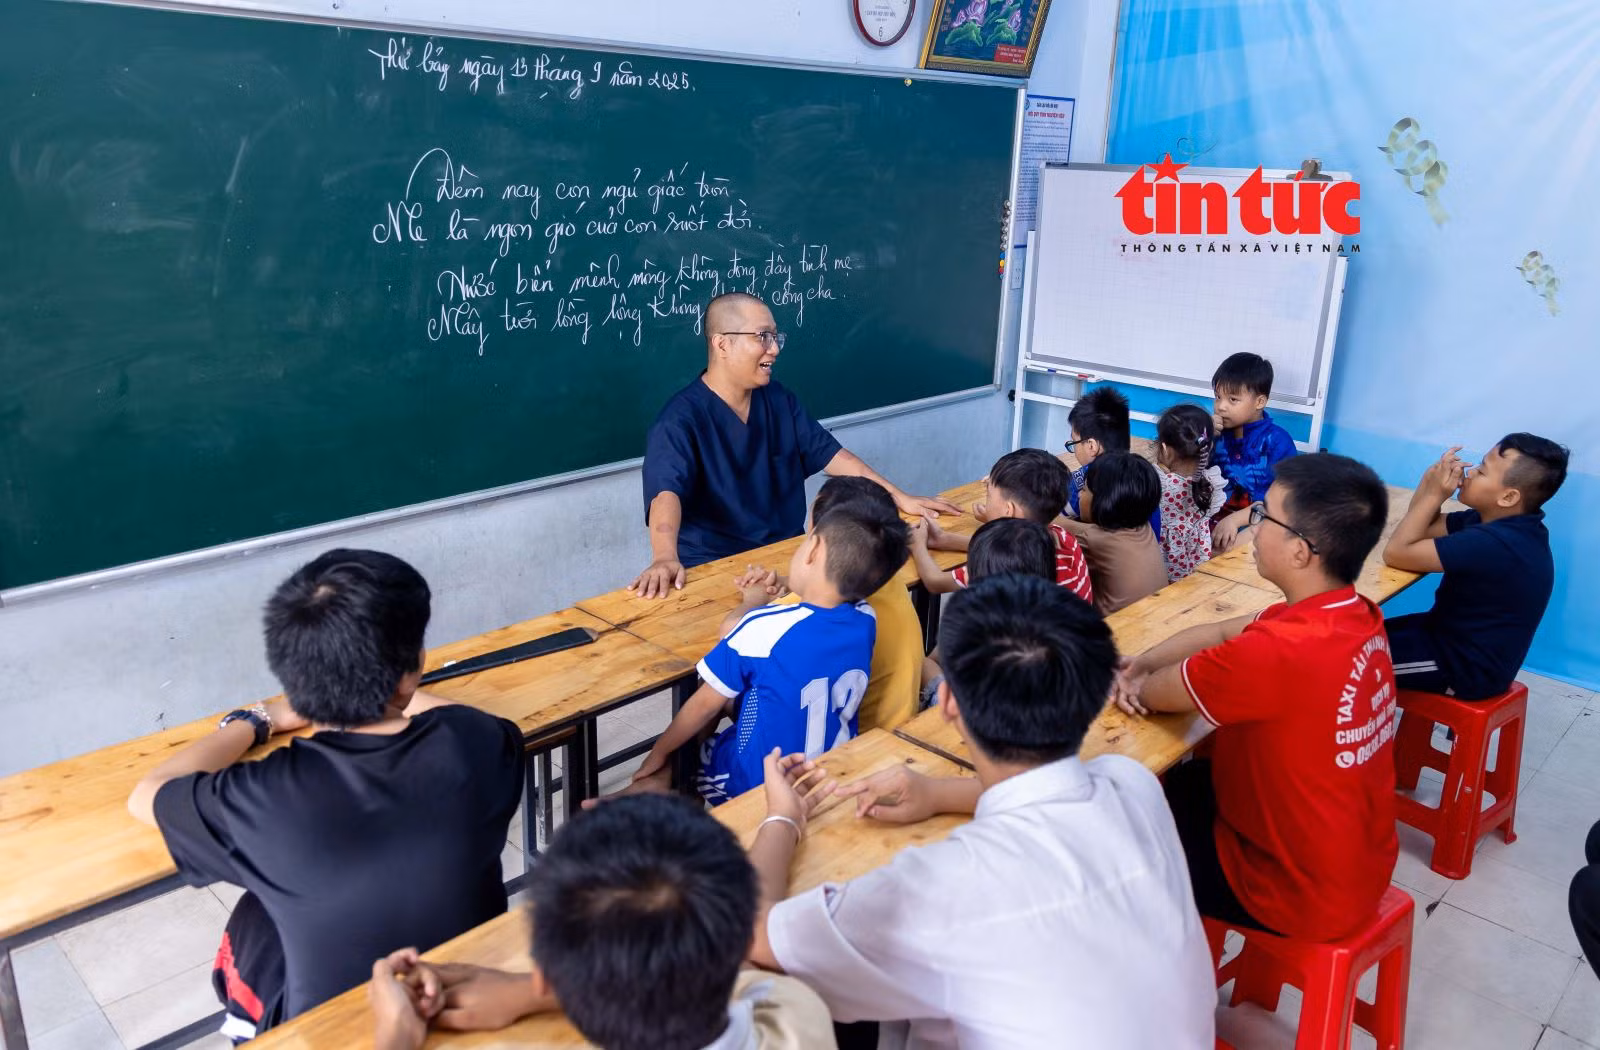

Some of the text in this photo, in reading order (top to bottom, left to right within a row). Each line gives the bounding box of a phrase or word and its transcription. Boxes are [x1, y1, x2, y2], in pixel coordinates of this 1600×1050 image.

[534, 53, 584, 100] tháng
[590, 61, 602, 83] 9
[609, 60, 643, 87] năm
[502, 184, 541, 220] nay
[555, 182, 591, 200] con
[601, 167, 642, 215] ngủ
[647, 161, 689, 214] giấc
[446, 208, 481, 241] là
[586, 205, 617, 235] của
[624, 216, 657, 234] con
[516, 259, 554, 295] biển
[569, 253, 620, 294] mênh
[627, 258, 672, 299] mông
[834, 255, 853, 277] mẹ
[1336, 684, 1358, 725] TAXI
[1350, 654, 1368, 681] TẢI
[800, 669, 869, 763] 12
[1336, 717, 1376, 745] CHUYỂN
